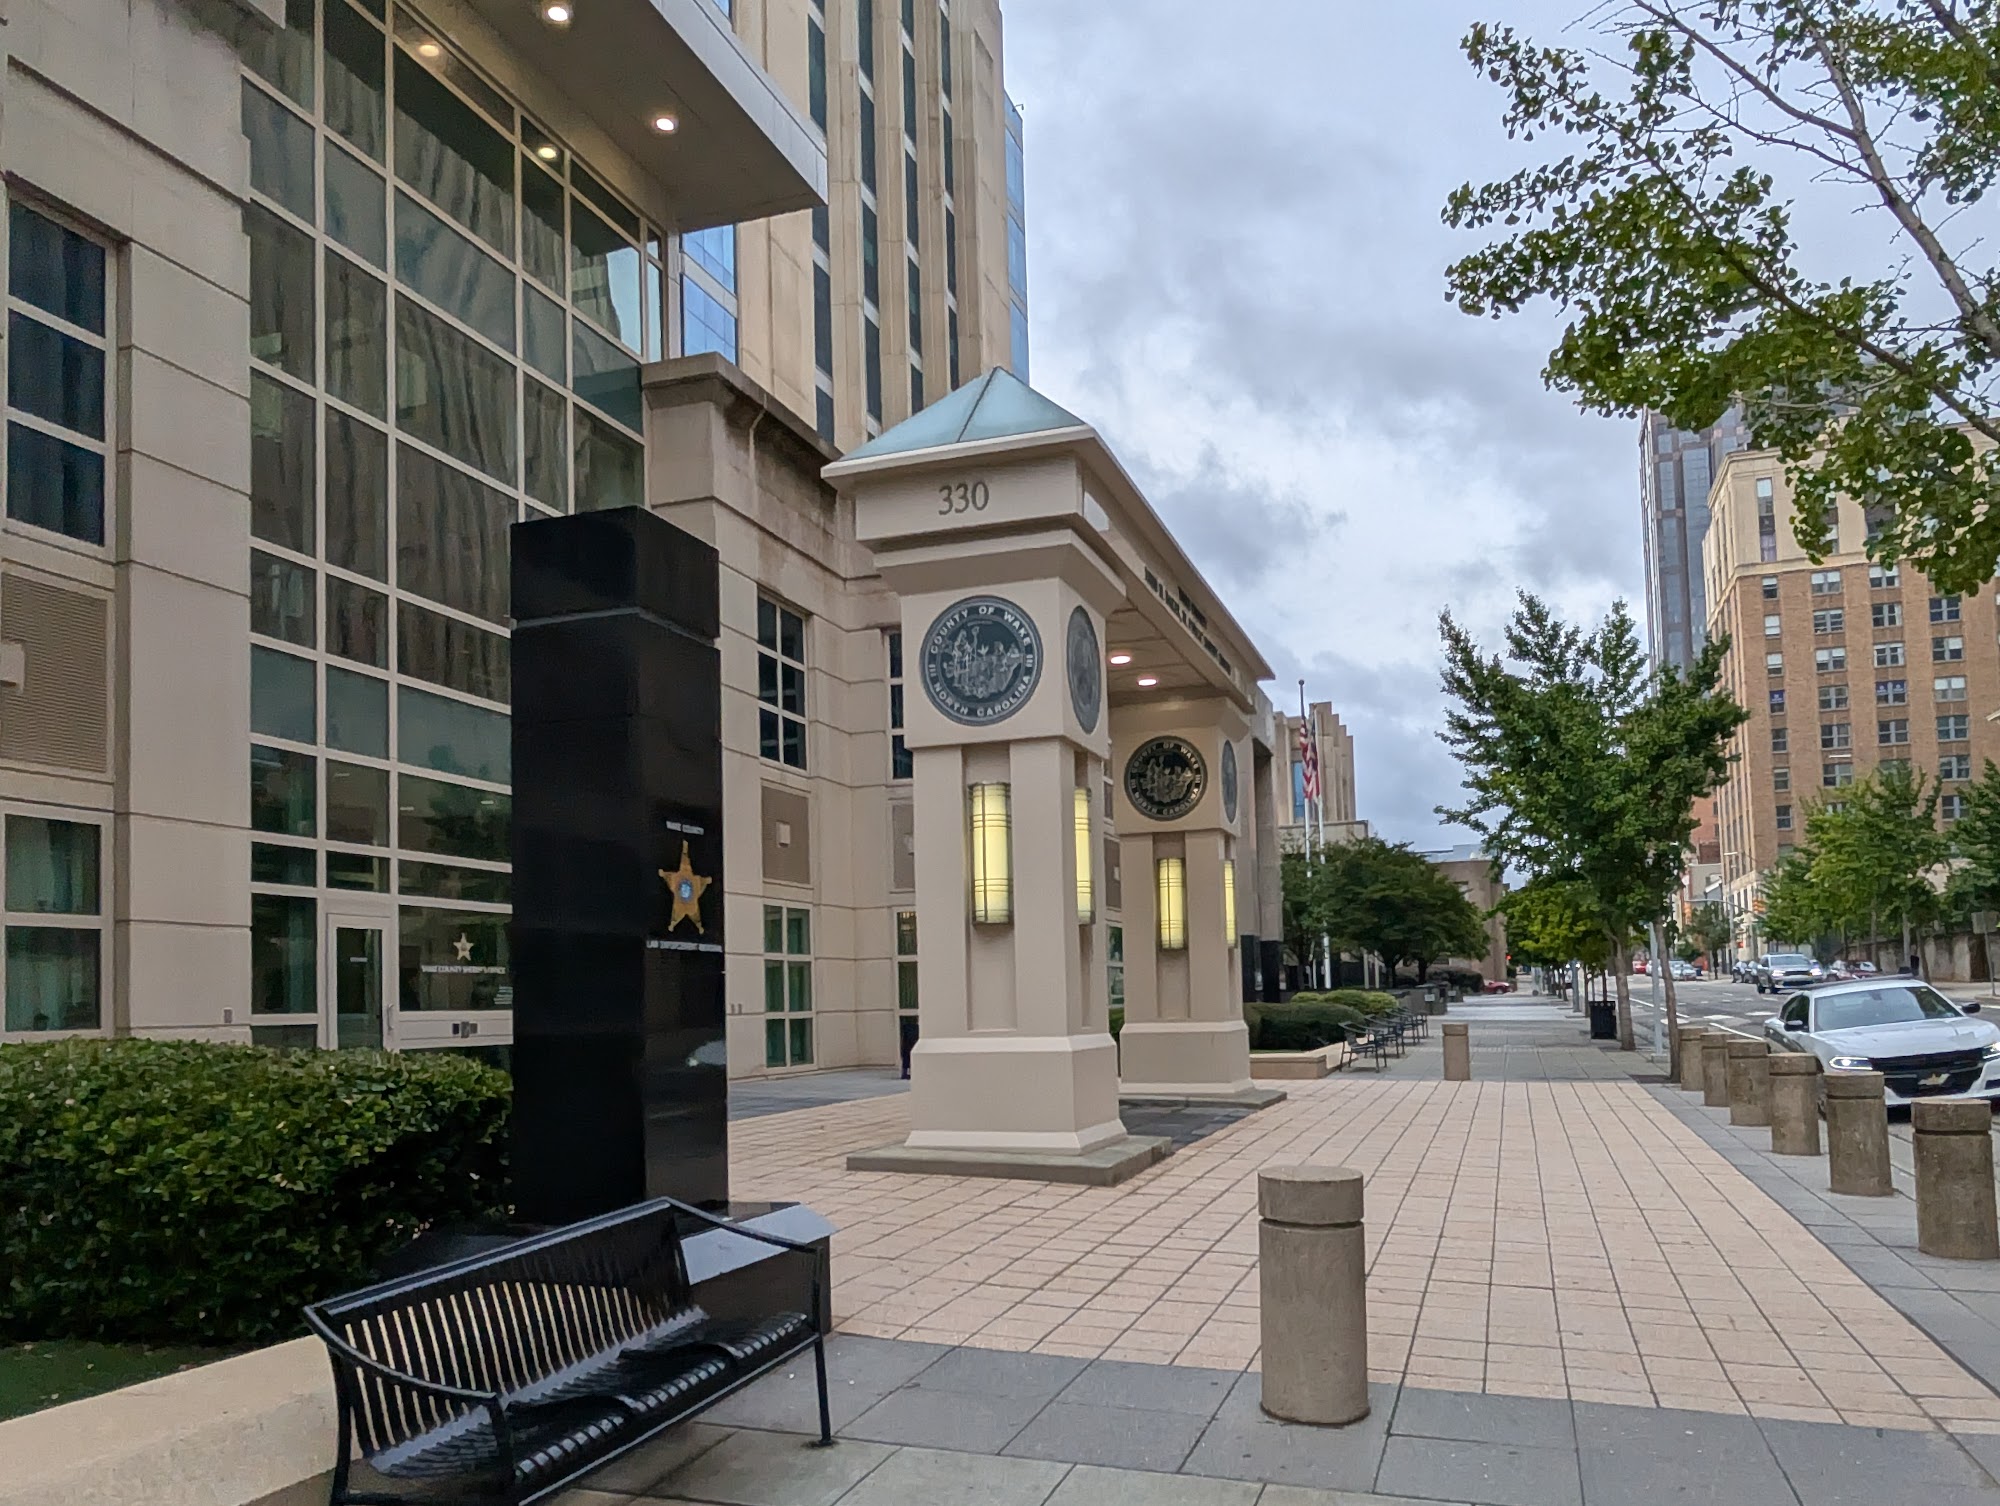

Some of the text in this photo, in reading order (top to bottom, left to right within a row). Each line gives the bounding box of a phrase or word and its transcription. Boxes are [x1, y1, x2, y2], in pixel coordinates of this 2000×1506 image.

[938, 481, 990, 515] 330
[930, 605, 1031, 654] COUNTY OF WAKE
[933, 676, 1031, 718] NORTH CAROLINA
